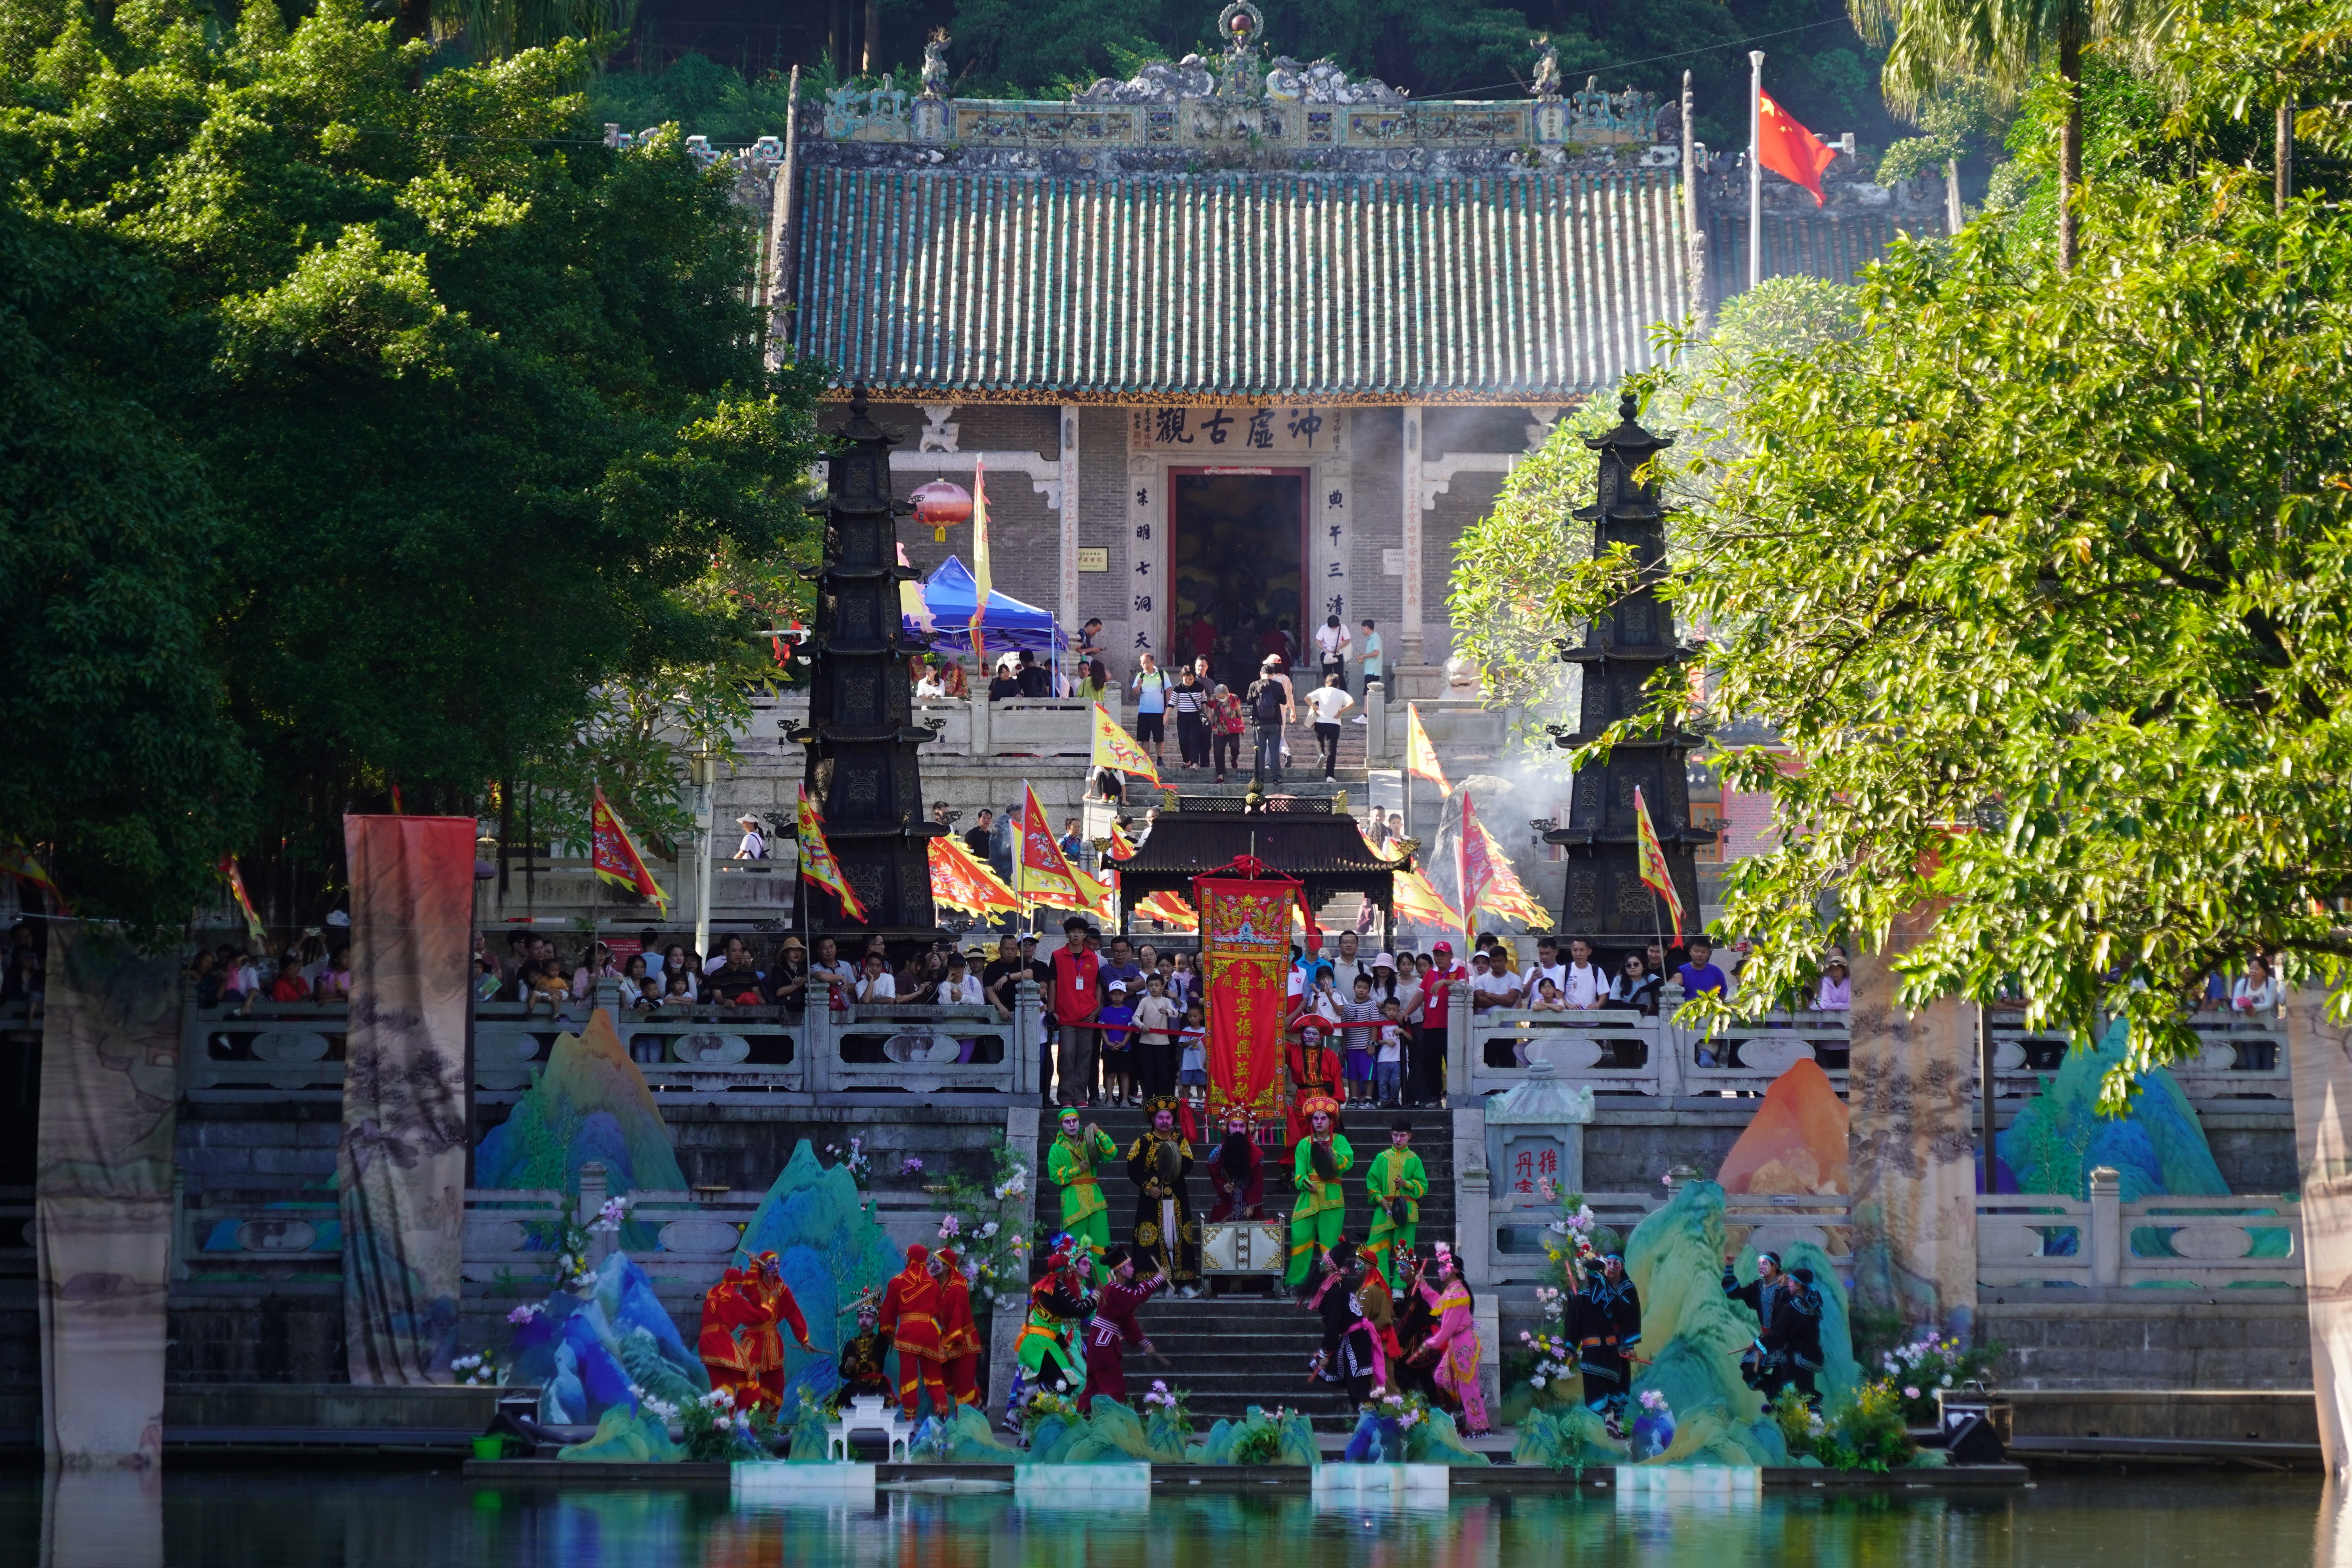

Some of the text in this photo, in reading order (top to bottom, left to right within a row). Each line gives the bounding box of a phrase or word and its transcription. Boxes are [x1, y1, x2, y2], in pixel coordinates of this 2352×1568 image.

[1134, 488, 1151, 648] 朱明七洞天
[1233, 978, 1253, 1101] 普寧振興英歌
